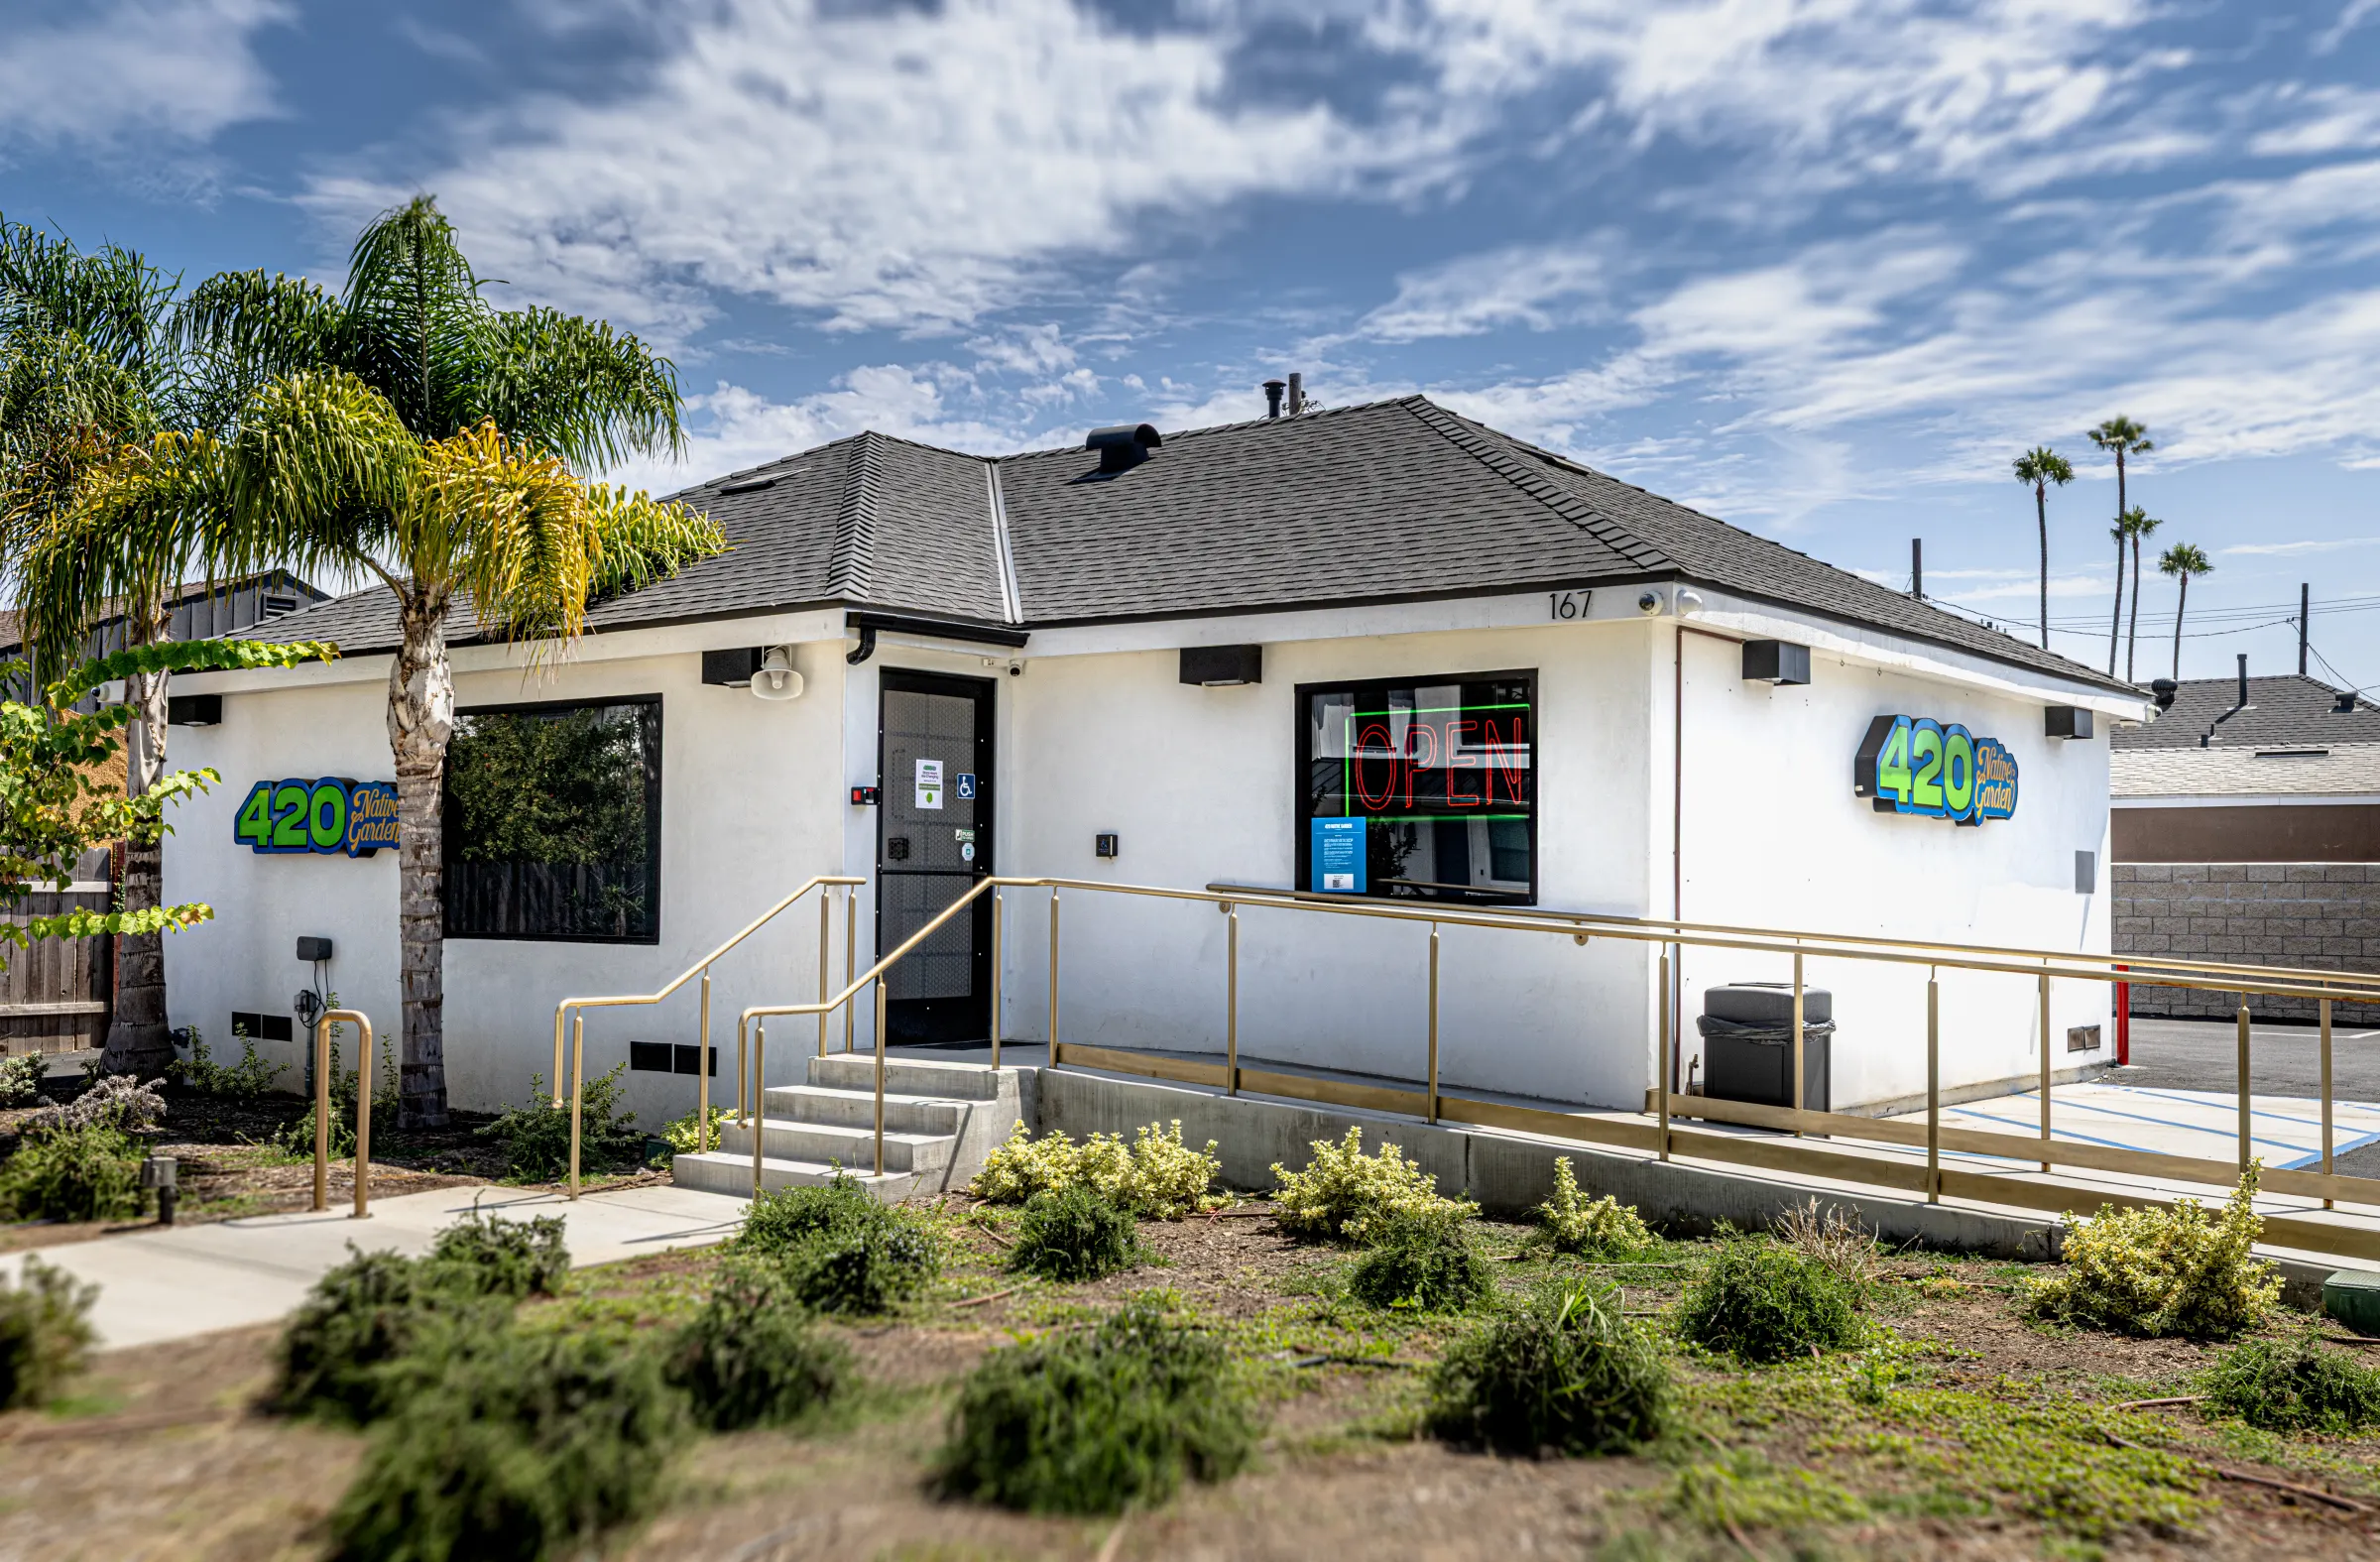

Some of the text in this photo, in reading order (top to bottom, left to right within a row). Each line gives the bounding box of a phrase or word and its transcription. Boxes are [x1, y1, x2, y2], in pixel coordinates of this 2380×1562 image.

[1550, 590, 1592, 619] 167
[1355, 717, 1522, 810] OPEN
[1879, 726, 1973, 812] 420
[1978, 747, 2015, 783] Native
[238, 784, 346, 847] 420
[354, 788, 400, 818] Native
[1975, 771, 2015, 818] Garden
[349, 810, 400, 851] Garden
